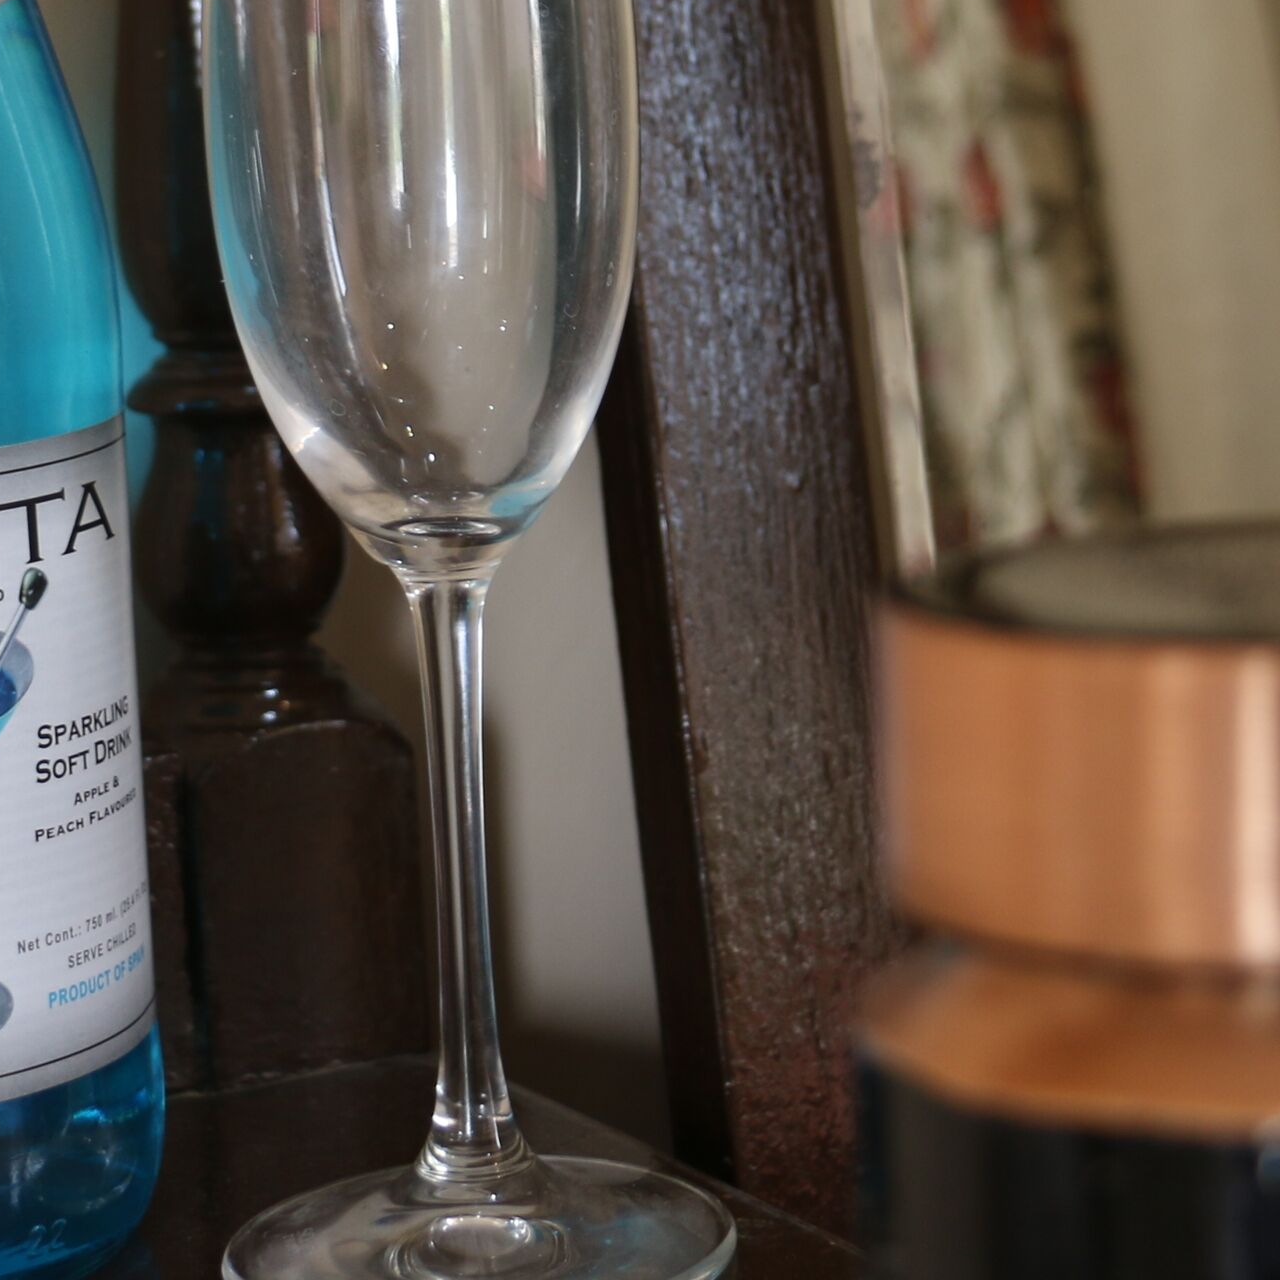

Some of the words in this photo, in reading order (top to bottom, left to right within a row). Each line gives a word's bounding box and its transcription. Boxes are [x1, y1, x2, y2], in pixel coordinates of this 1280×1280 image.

[36, 695, 130, 750] SPARKLING
[35, 749, 91, 785] SOFT
[94, 726, 134, 766] DRINK
[73, 781, 111, 807] APPLE
[34, 817, 86, 844] PEACH
[17, 937, 41, 955] Net
[85, 914, 104, 933] 750
[67, 942, 105, 969] SERVE
[106, 922, 137, 952] CHILLED
[48, 969, 111, 1009] PRODUCT
[113, 960, 126, 982] OF
